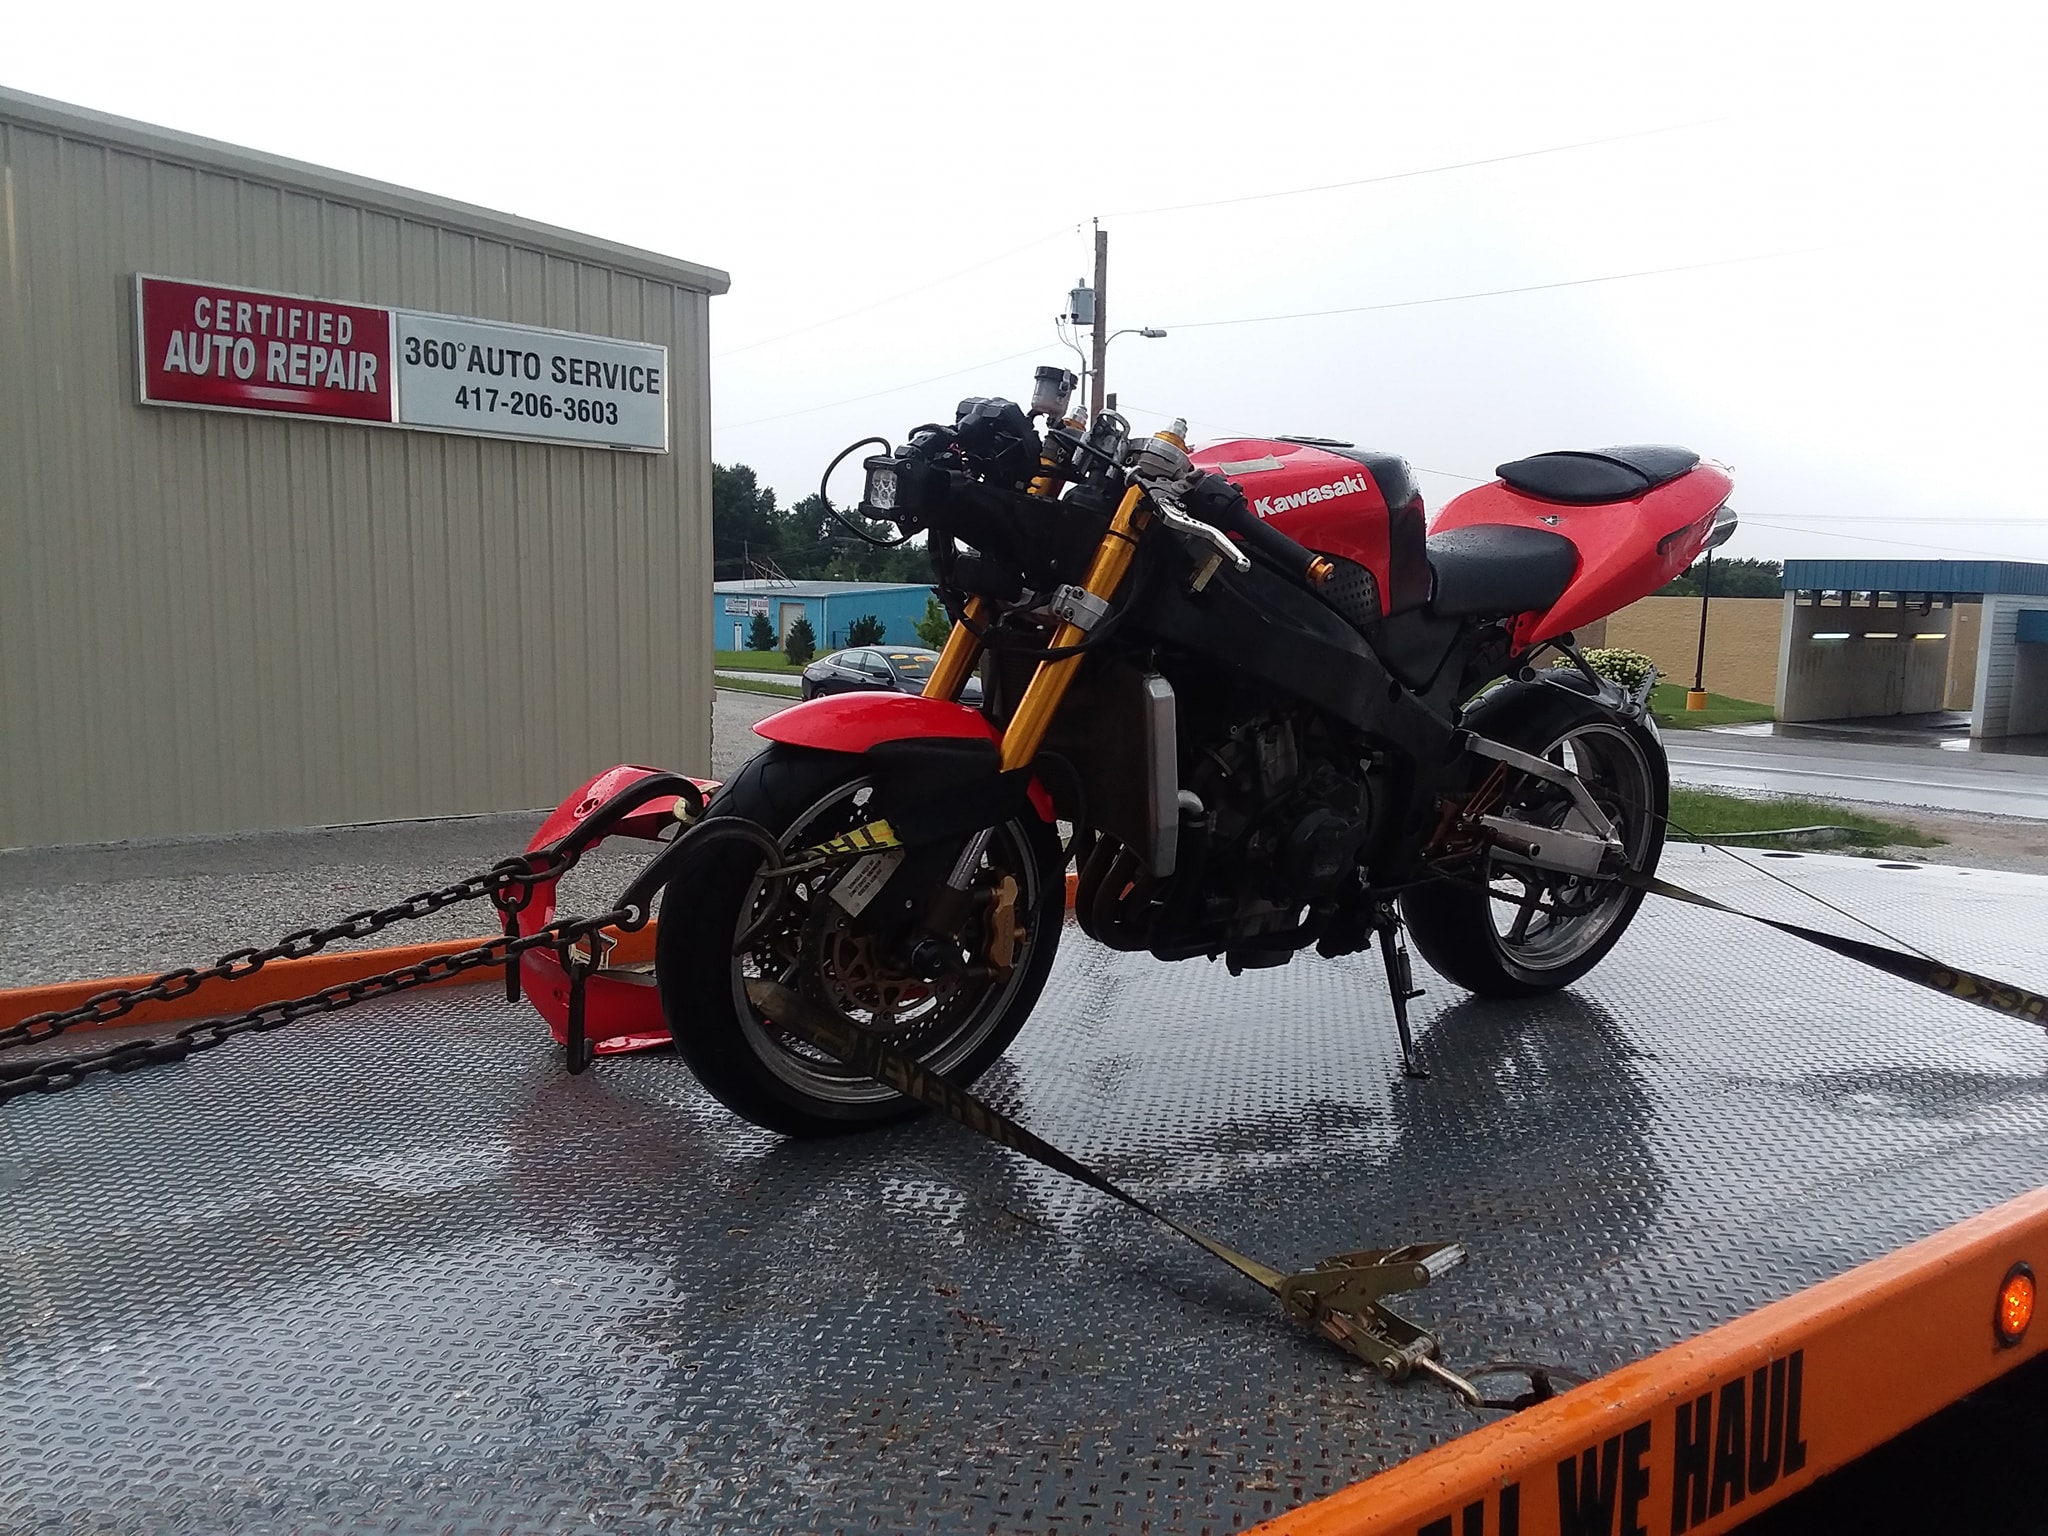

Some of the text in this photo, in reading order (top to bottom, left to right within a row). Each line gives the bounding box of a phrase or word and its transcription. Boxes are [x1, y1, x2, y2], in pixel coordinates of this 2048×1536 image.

[194, 296, 353, 345] CERTIFIED
[163, 330, 379, 394] AUTO REPAIR
[467, 345, 541, 381] AUTO
[551, 354, 660, 395] SERVICE
[454, 385, 619, 425] 417-206-3603
[1254, 473, 1367, 518] Kawasaki
[1557, 1349, 1807, 1536] WE HAUL
